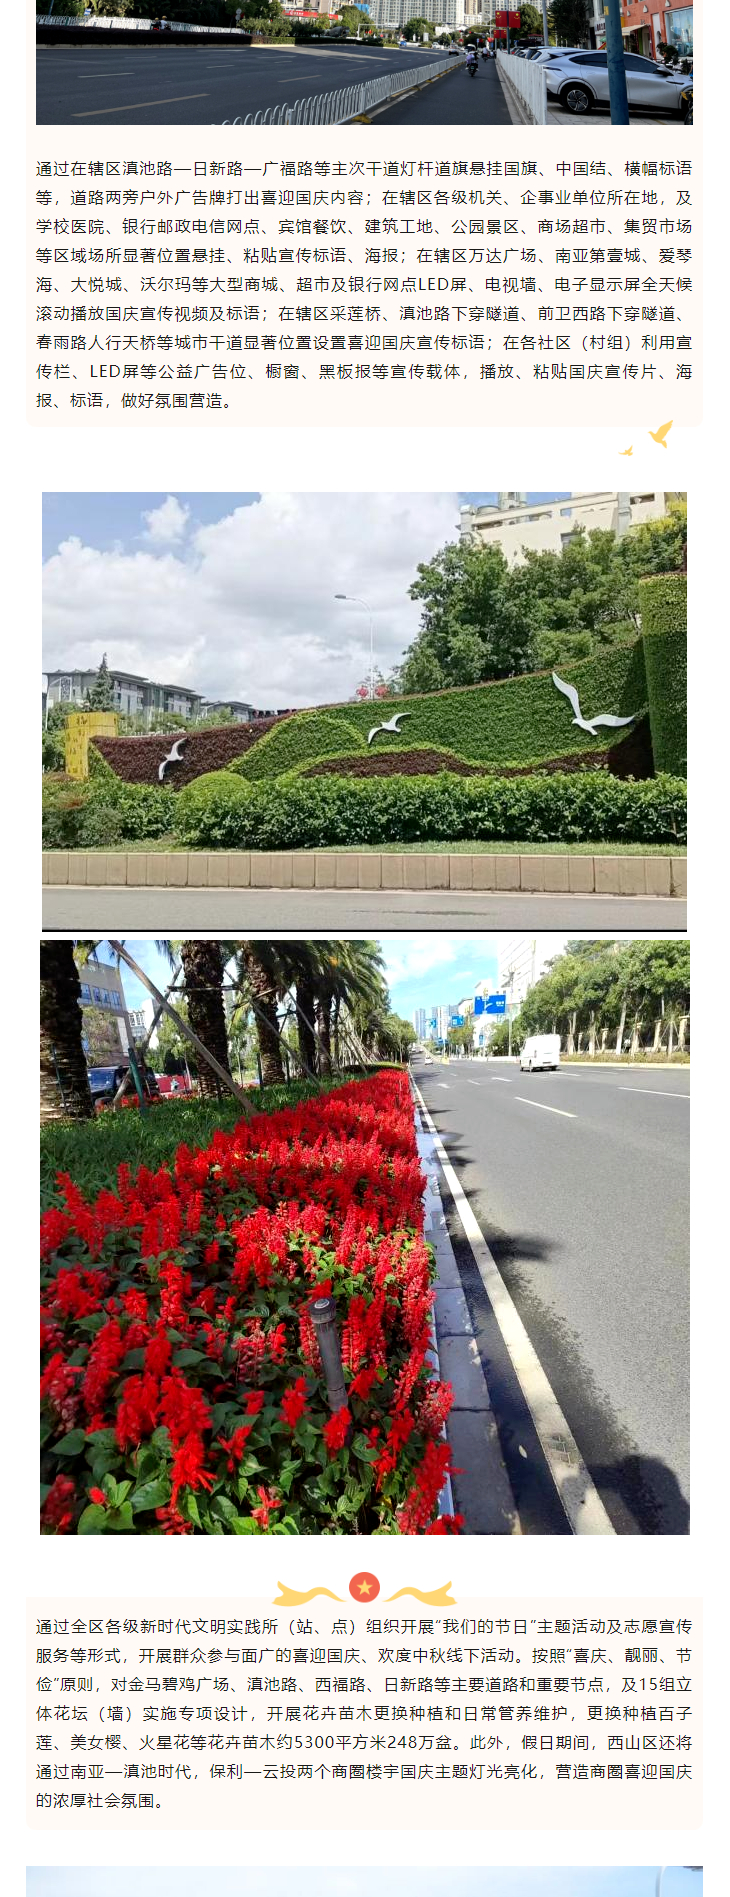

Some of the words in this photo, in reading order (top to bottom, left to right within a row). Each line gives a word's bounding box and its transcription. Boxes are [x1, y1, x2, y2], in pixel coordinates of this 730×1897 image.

[36, 160, 692, 177] 通过在辖区滇池路—日新路—广福路等主次干道灯杆道旗悬挂国旗、中国结、横幅标语
[36, 189, 692, 206] 等，道路两旁户外广告牌打出喜迎国庆内容；在辖区各级机关、企事业单位所在地，及
[36, 218, 692, 235] 学校医院、银行邮政电信网点、宾馆餐饮、建筑工地、公园景区、商场超市、集贸市场
[36, 247, 692, 264] 等区域场所显著位置悬挂、粘贴宣传标语、海报；在辖区万达广场、南亚第壹城、爱琴
[36, 276, 692, 293] 海、大悦城、沃尔玛等大型商城、超市及银行网点LED屏、电视墙、电子显示屏全天候
[36, 305, 683, 322] 滚动播放国庆宣传视频及标语；在辖区采莲桥、滇池路下穿隧道、前卫西路下穿隧道、
[36, 334, 692, 351] 春雨路人行天桥等城市干道显著位置设置喜迎国庆宣传标语；在各社区（村组）利用宣
[36, 363, 692, 380] 传栏、LED屏等公益广告位、橱窗、黑板报等宣传载体，播放、粘贴国庆宣传片、海
[36, 392, 230, 409] 报、标语，做好氛围营造。
[36, 1705, 692, 1722] 体花坛（墙）实施专项设计，开展花卉苗木更换种植和日常管养维护，更换种植百子
[36, 1734, 692, 1751] 莲、美女樱、火星花等花卉苗木约5300平方米248万盆。此外，假日期间，西山区还将
[36, 1792, 162, 1809] 的浓厚社会氛围。
